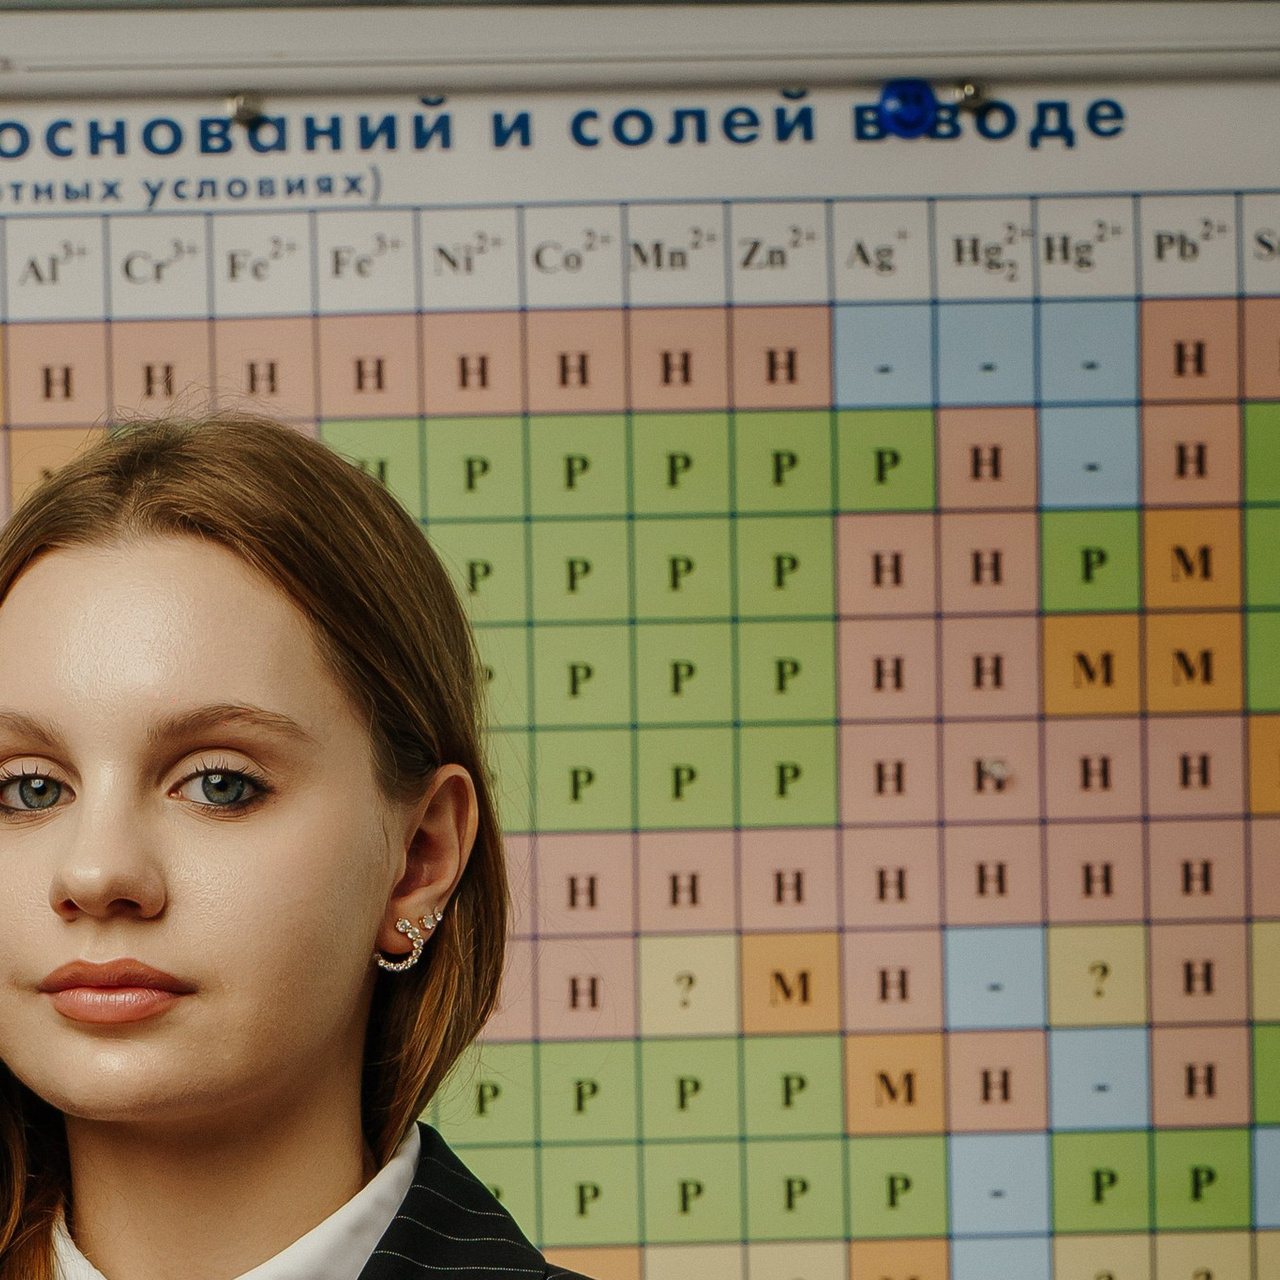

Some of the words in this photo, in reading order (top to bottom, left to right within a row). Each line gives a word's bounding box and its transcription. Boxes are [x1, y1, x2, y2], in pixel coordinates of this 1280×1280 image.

[493, 115, 531, 149] и
[571, 91, 817, 147] солей
[928, 98, 1125, 149] воде
[144, 165, 382, 211] условиях)
[675, 972, 697, 1009] ?
[1089, 961, 1111, 998] ?
